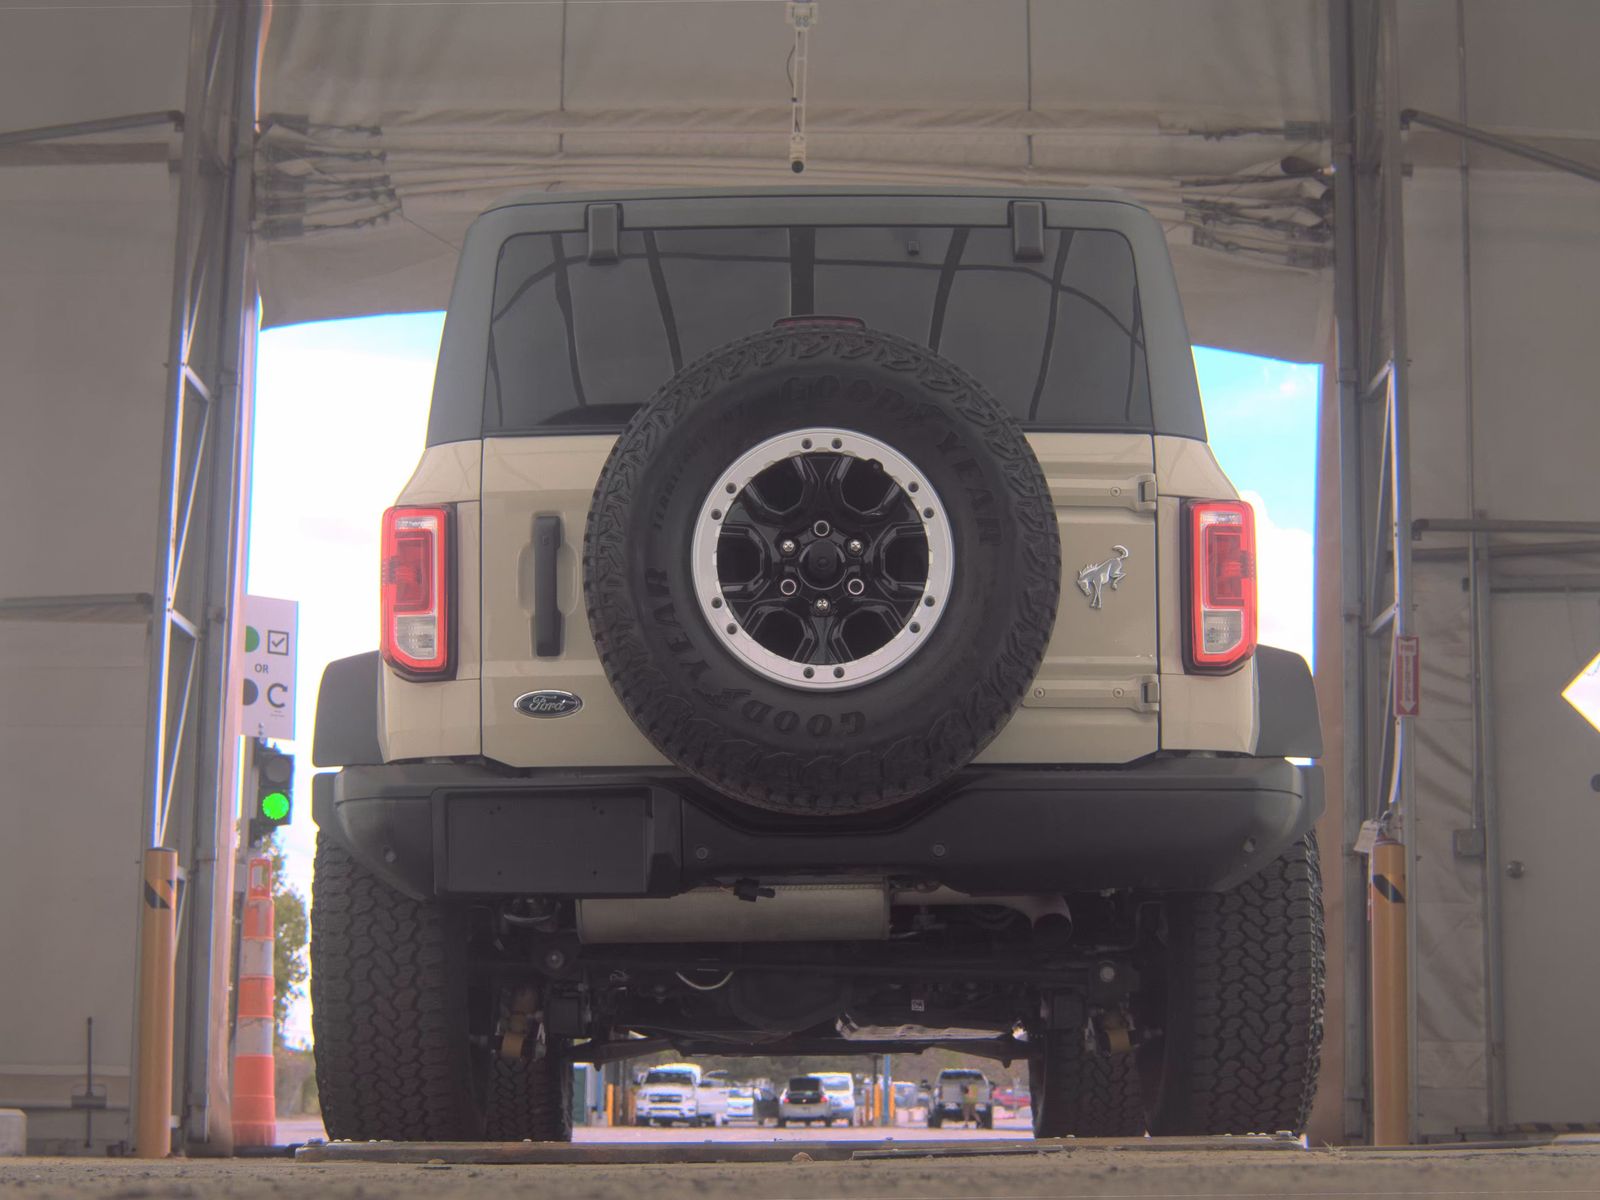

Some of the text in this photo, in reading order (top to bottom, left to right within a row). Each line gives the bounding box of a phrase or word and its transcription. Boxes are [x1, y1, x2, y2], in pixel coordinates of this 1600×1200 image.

[644, 566, 867, 738] GOODYEAR
[254, 663, 269, 673] OR
[528, 695, 566, 711] Ford
